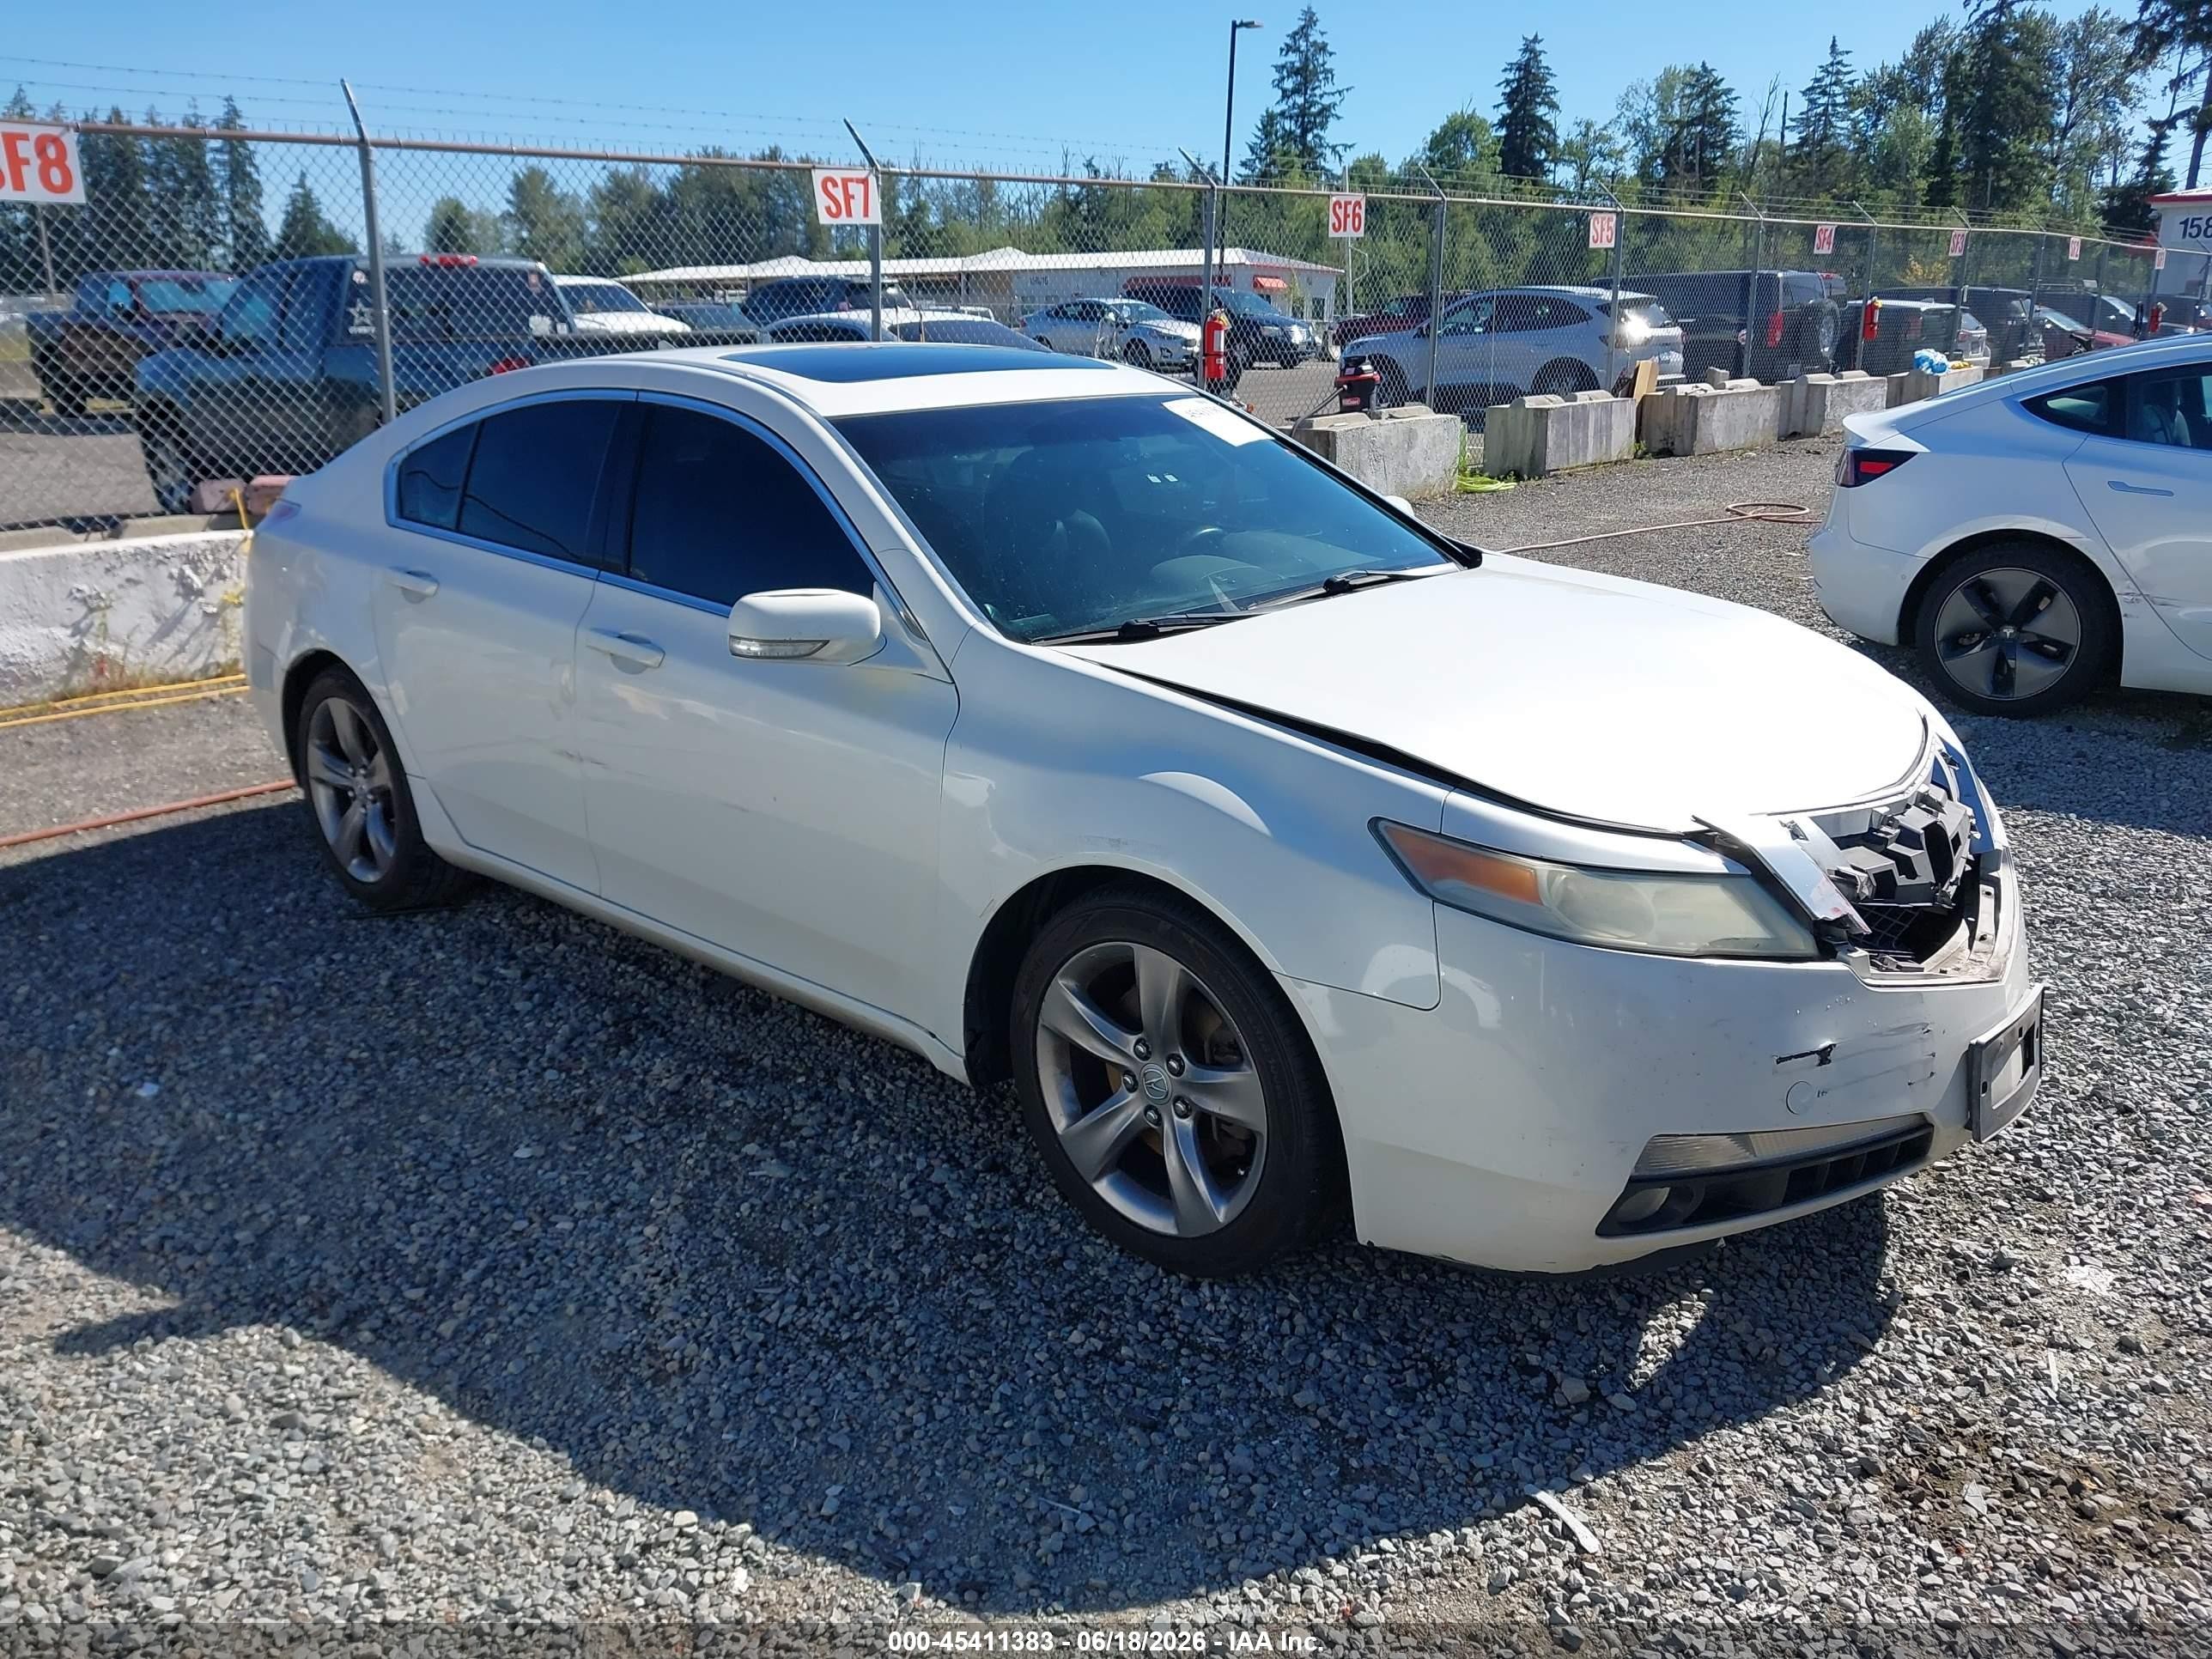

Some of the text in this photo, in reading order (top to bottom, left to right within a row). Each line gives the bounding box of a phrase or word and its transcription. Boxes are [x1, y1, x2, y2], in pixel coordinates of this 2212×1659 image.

[0, 131, 74, 194] F8
[821, 176, 869, 218] SF7
[1332, 200, 1362, 233] SF6
[1593, 216, 1613, 244] SF5
[1816, 228, 1833, 250] SF4
[1951, 233, 1965, 253] SF3
